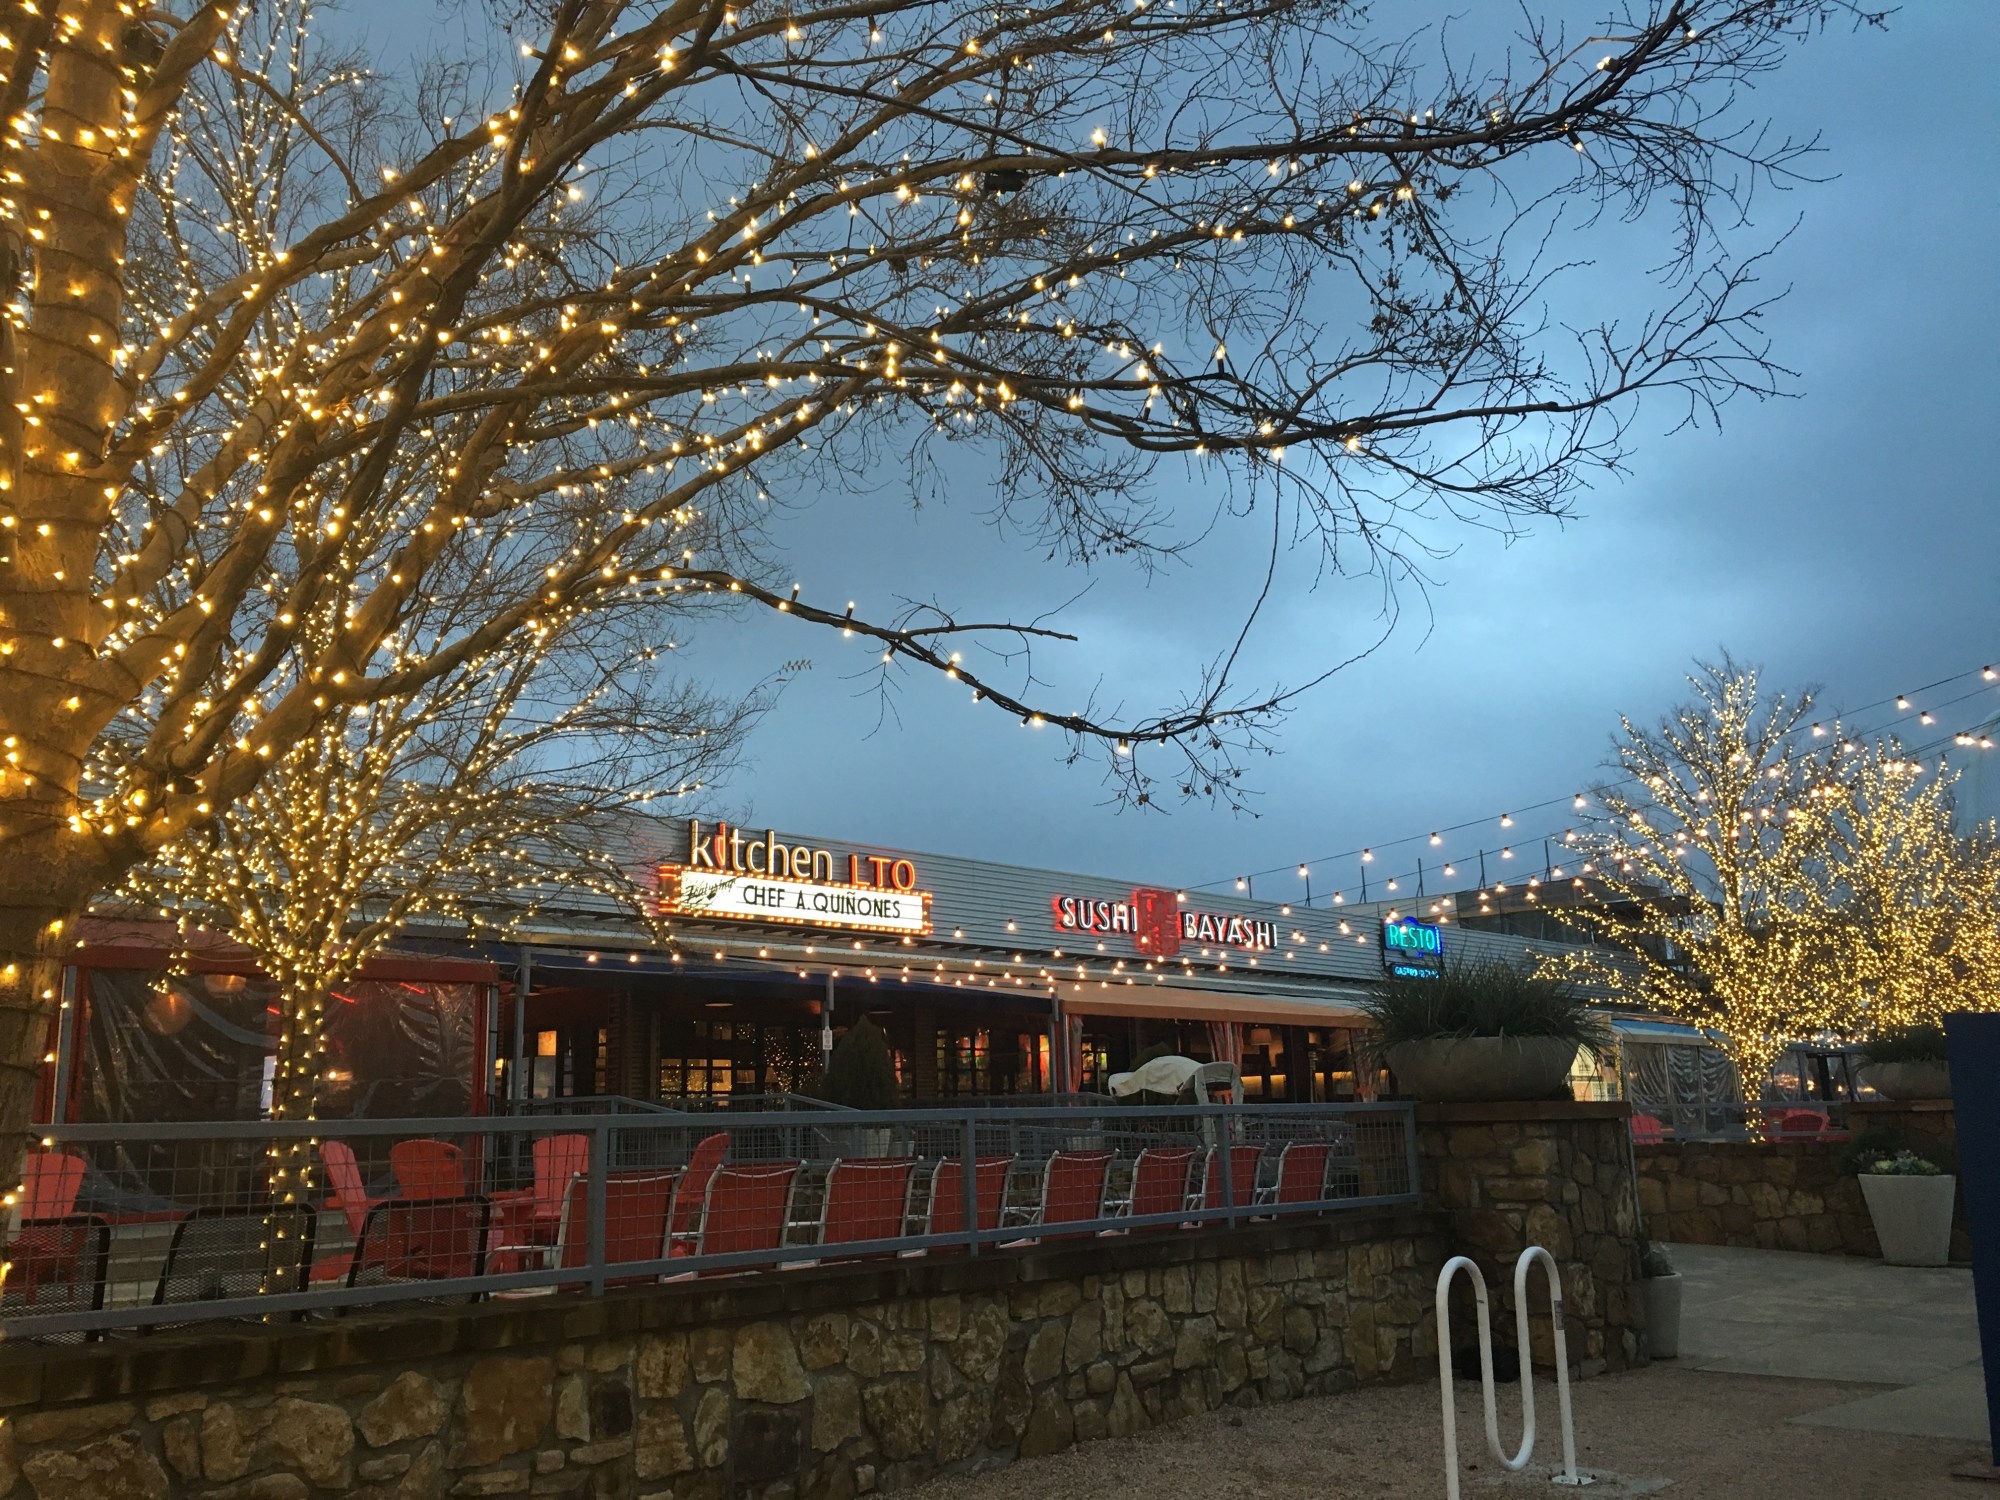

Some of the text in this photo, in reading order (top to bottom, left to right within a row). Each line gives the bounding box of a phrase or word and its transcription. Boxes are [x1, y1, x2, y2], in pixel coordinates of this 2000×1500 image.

[688, 818, 916, 891] kitchen LTO
[743, 884, 785, 908] CHEF
[1060, 896, 1138, 933] SUSHI
[1182, 912, 1278, 948] BAYASHI
[1389, 924, 1435, 950] RESTO
